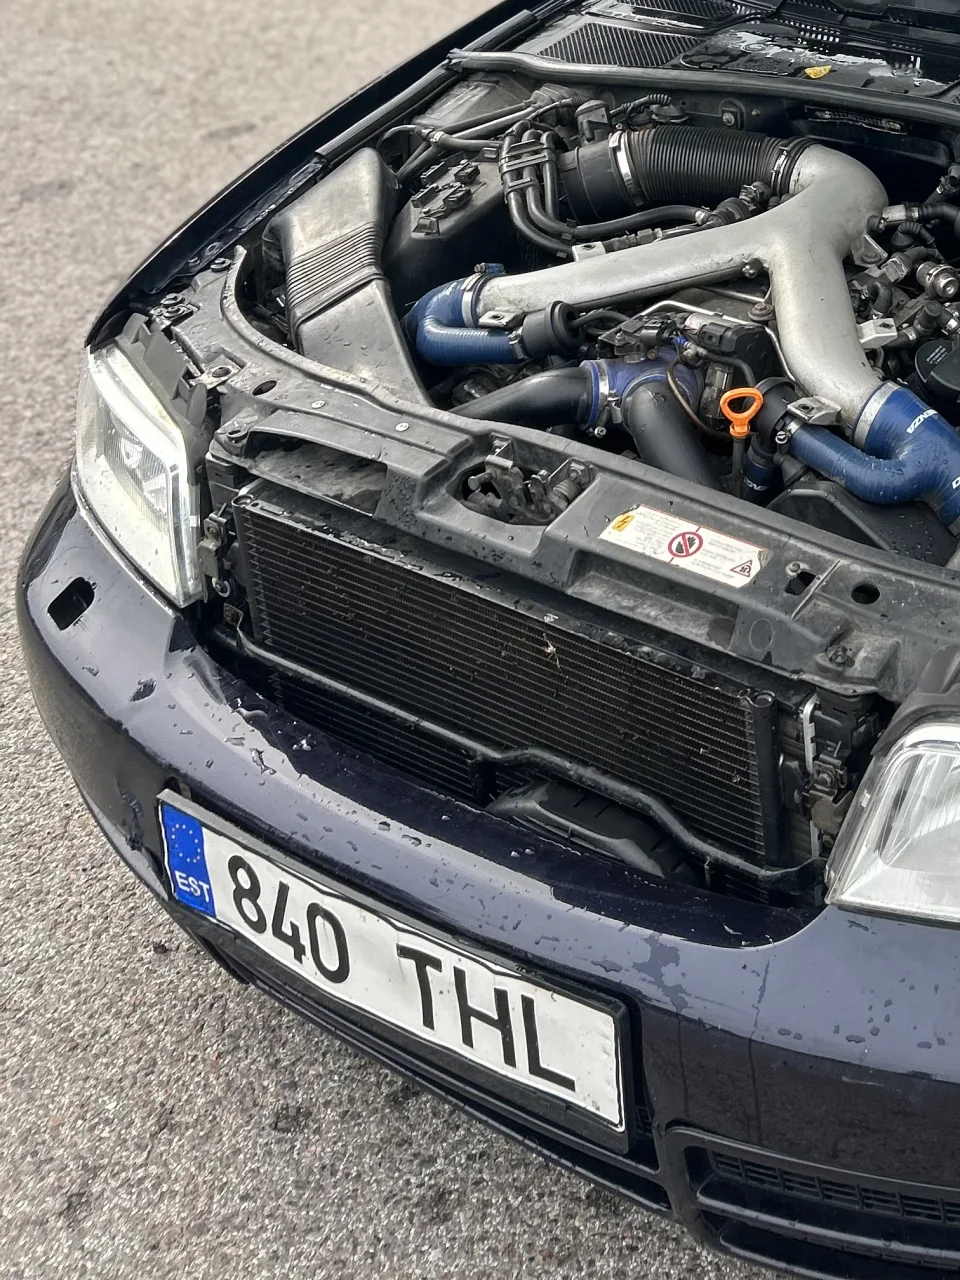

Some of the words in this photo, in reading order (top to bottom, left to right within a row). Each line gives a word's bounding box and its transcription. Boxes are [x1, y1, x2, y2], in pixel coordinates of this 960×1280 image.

[174, 869, 210, 903] EST
[227, 854, 350, 984] 840
[396, 942, 576, 1092] THL
